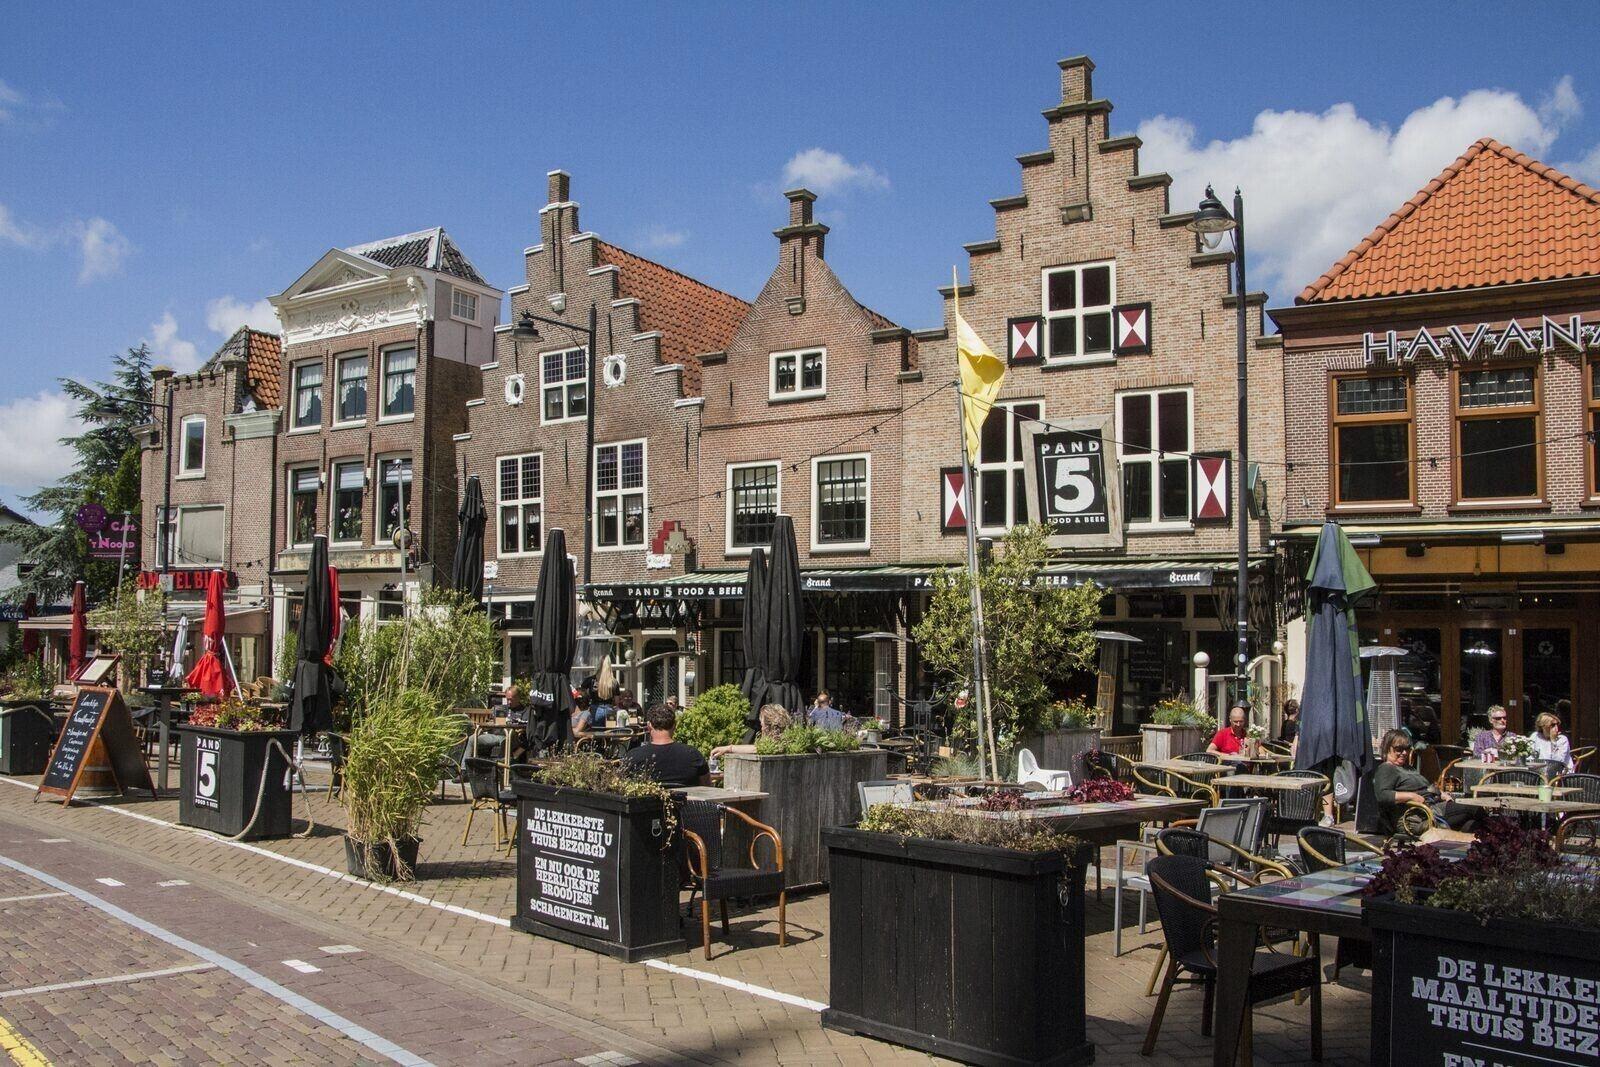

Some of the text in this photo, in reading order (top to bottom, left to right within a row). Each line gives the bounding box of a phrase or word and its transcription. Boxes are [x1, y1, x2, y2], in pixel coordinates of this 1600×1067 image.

[1363, 314, 1600, 364] HAVAN
[1041, 440, 1100, 455] PAND
[1054, 457, 1095, 513] 5
[136, 571, 229, 590] AMEL BIR
[806, 577, 831, 588] Brand
[914, 577, 956, 587] PAD
[1169, 571, 1200, 583] Brand
[628, 586, 743, 598] PAND 5 FOOD & BEER
[196, 738, 220, 750] PAND
[199, 751, 216, 798] 5
[534, 807, 605, 831] DE LEKKERSTE
[526, 818, 613, 847] MAALTIJDEN BIJ U
[531, 833, 606, 858] THUIS BEZORGD
[535, 856, 600, 883] EN NU OOK DE
[536, 869, 599, 895] HEERLIJKSTE
[541, 882, 593, 906] BROODJES!
[530, 898, 610, 930] SCHAGENEET.NL
[1437, 955, 1477, 983] DE
[1411, 976, 1600, 1030] MAALTIJDE
[1427, 1002, 1600, 1057] THUIS BEZ
